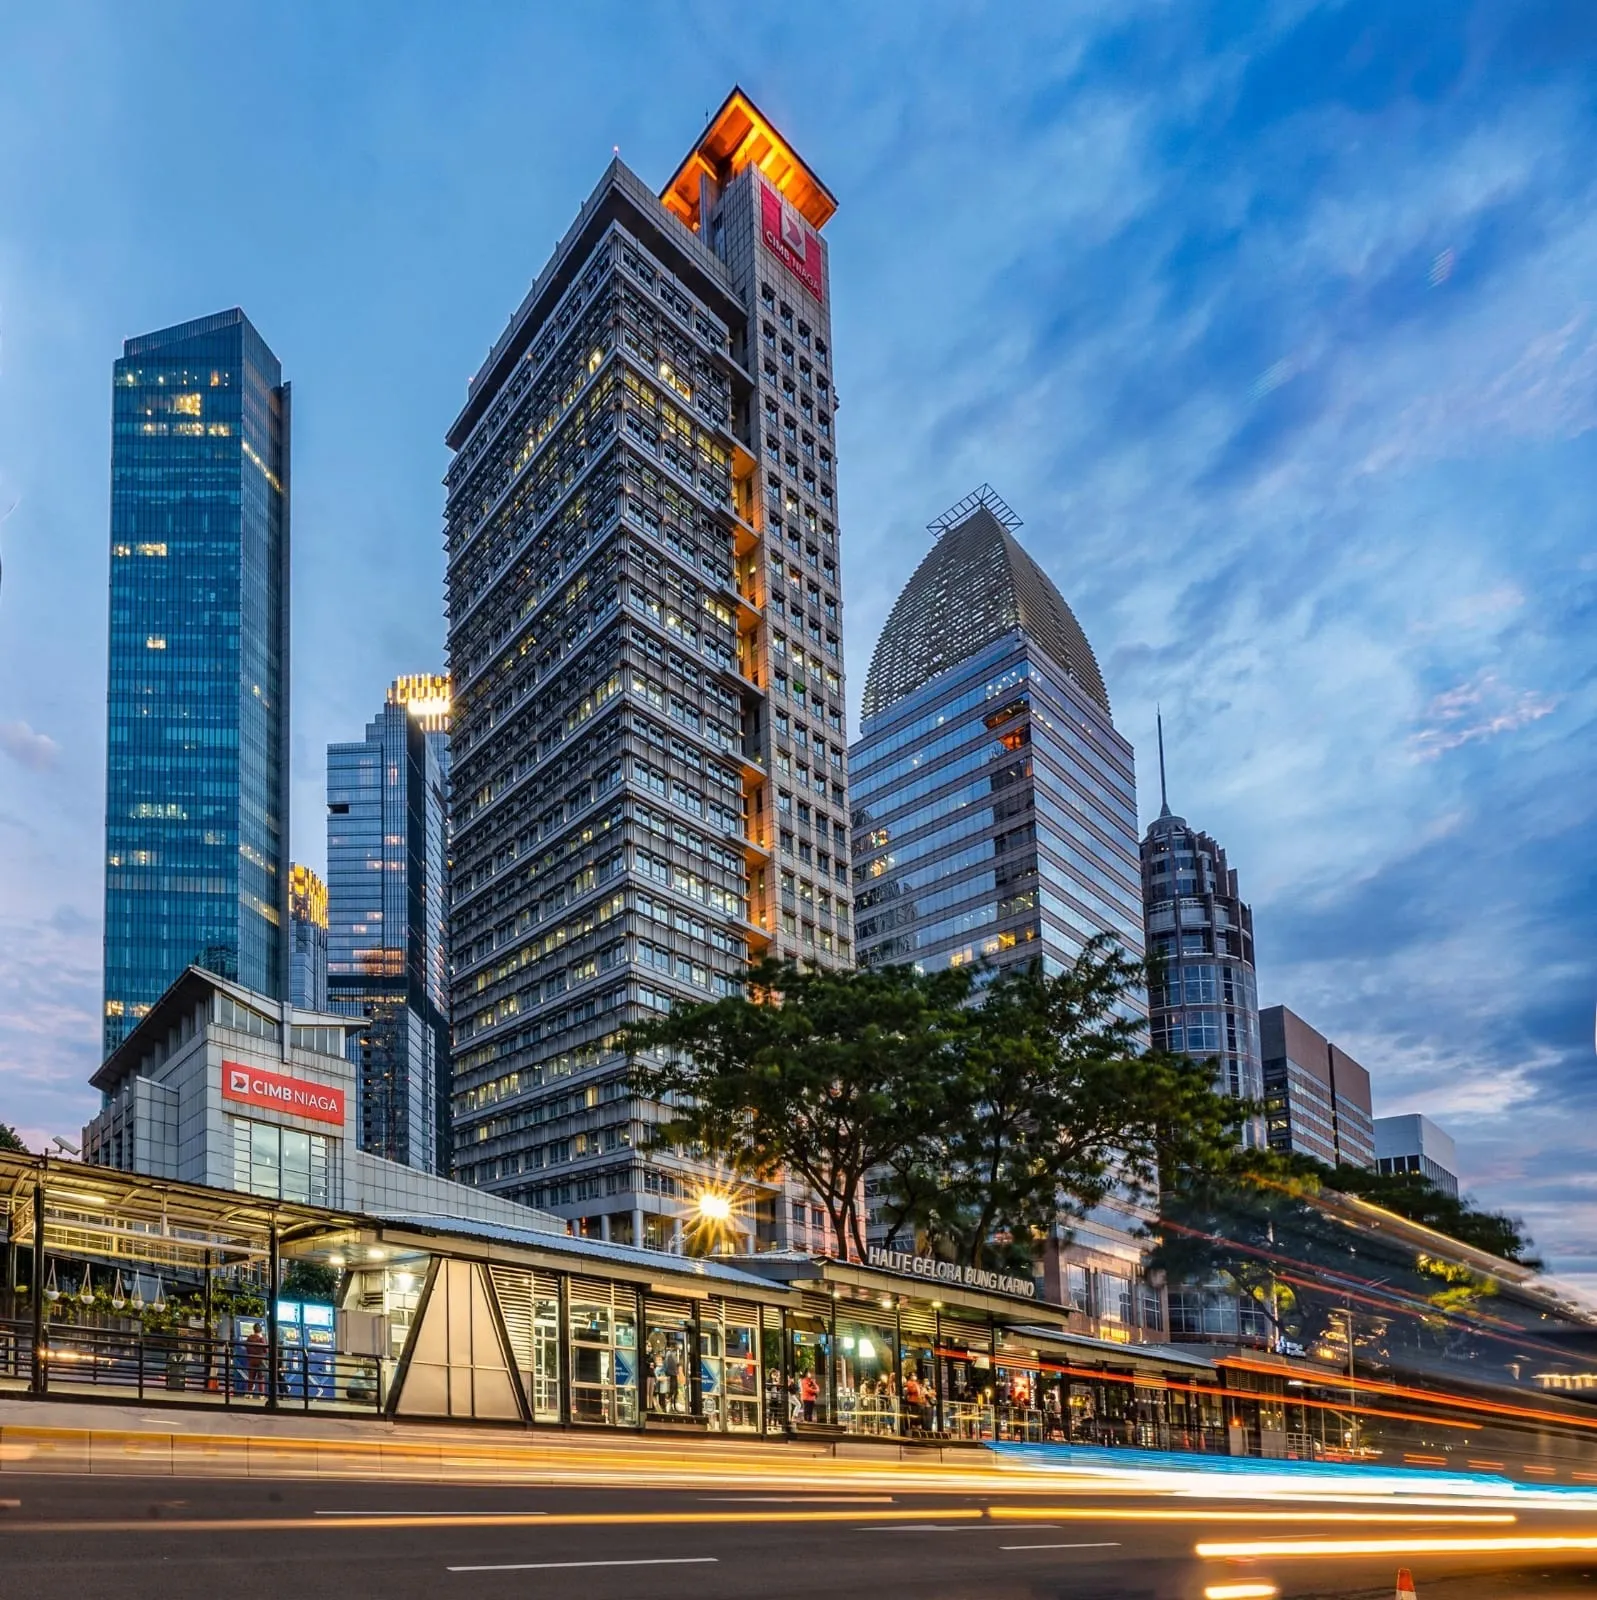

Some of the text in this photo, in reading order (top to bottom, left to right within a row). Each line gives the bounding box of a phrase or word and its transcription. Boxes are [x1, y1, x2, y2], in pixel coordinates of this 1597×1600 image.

[766, 230, 821, 293] CIMB NIAGA
[252, 1080, 338, 1112] CIMB NIAGA
[868, 1246, 1035, 1297] HALTE GELORA BUNG KARNO
